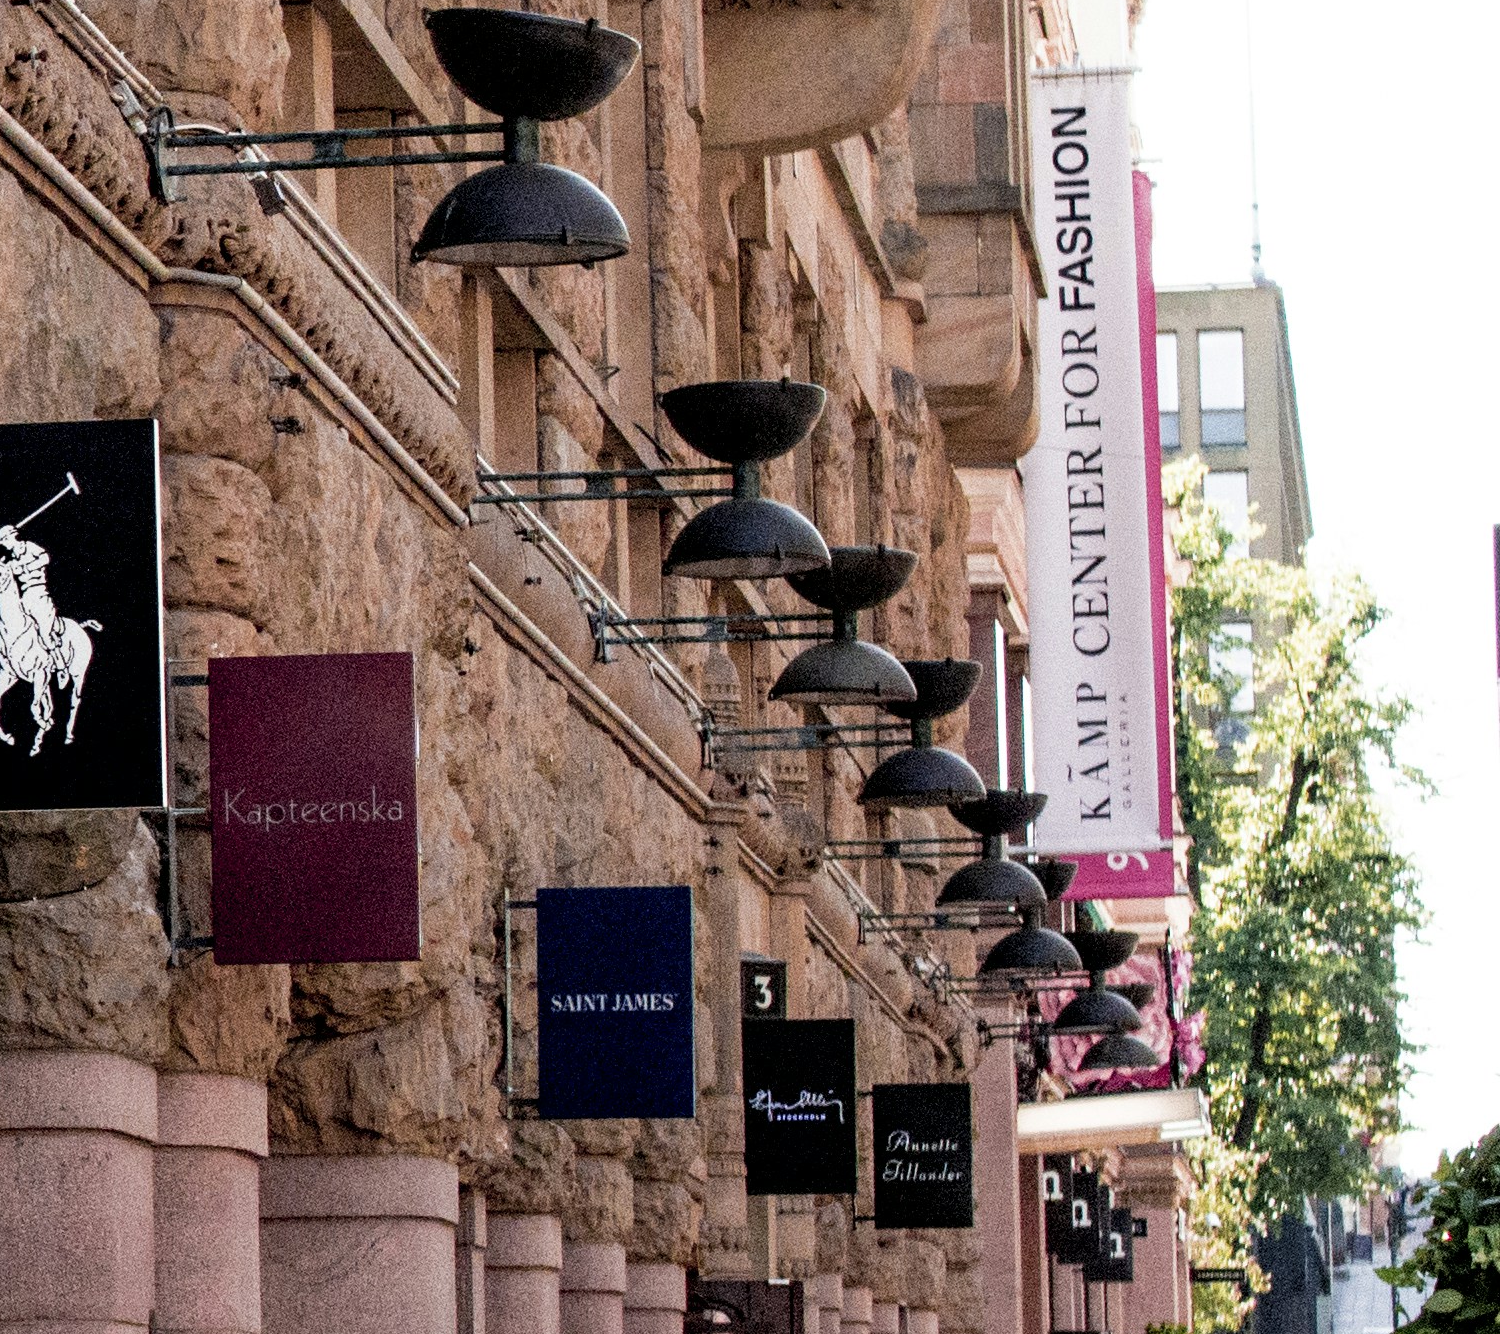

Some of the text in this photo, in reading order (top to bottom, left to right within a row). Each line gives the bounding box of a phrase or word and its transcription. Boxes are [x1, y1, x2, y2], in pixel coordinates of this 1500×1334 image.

[1050, 106, 1096, 312] FASHION
[1062, 328, 1103, 445] FOR
[1067, 450, 1113, 657] CENTER
[223, 786, 403, 833] Kapteenska
[550, 991, 675, 1015] SAINT JAMES
[754, 975, 773, 1009] 3
[776, 1113, 827, 1122] STOCKHOLM
[882, 1158, 964, 1183] Tillander
